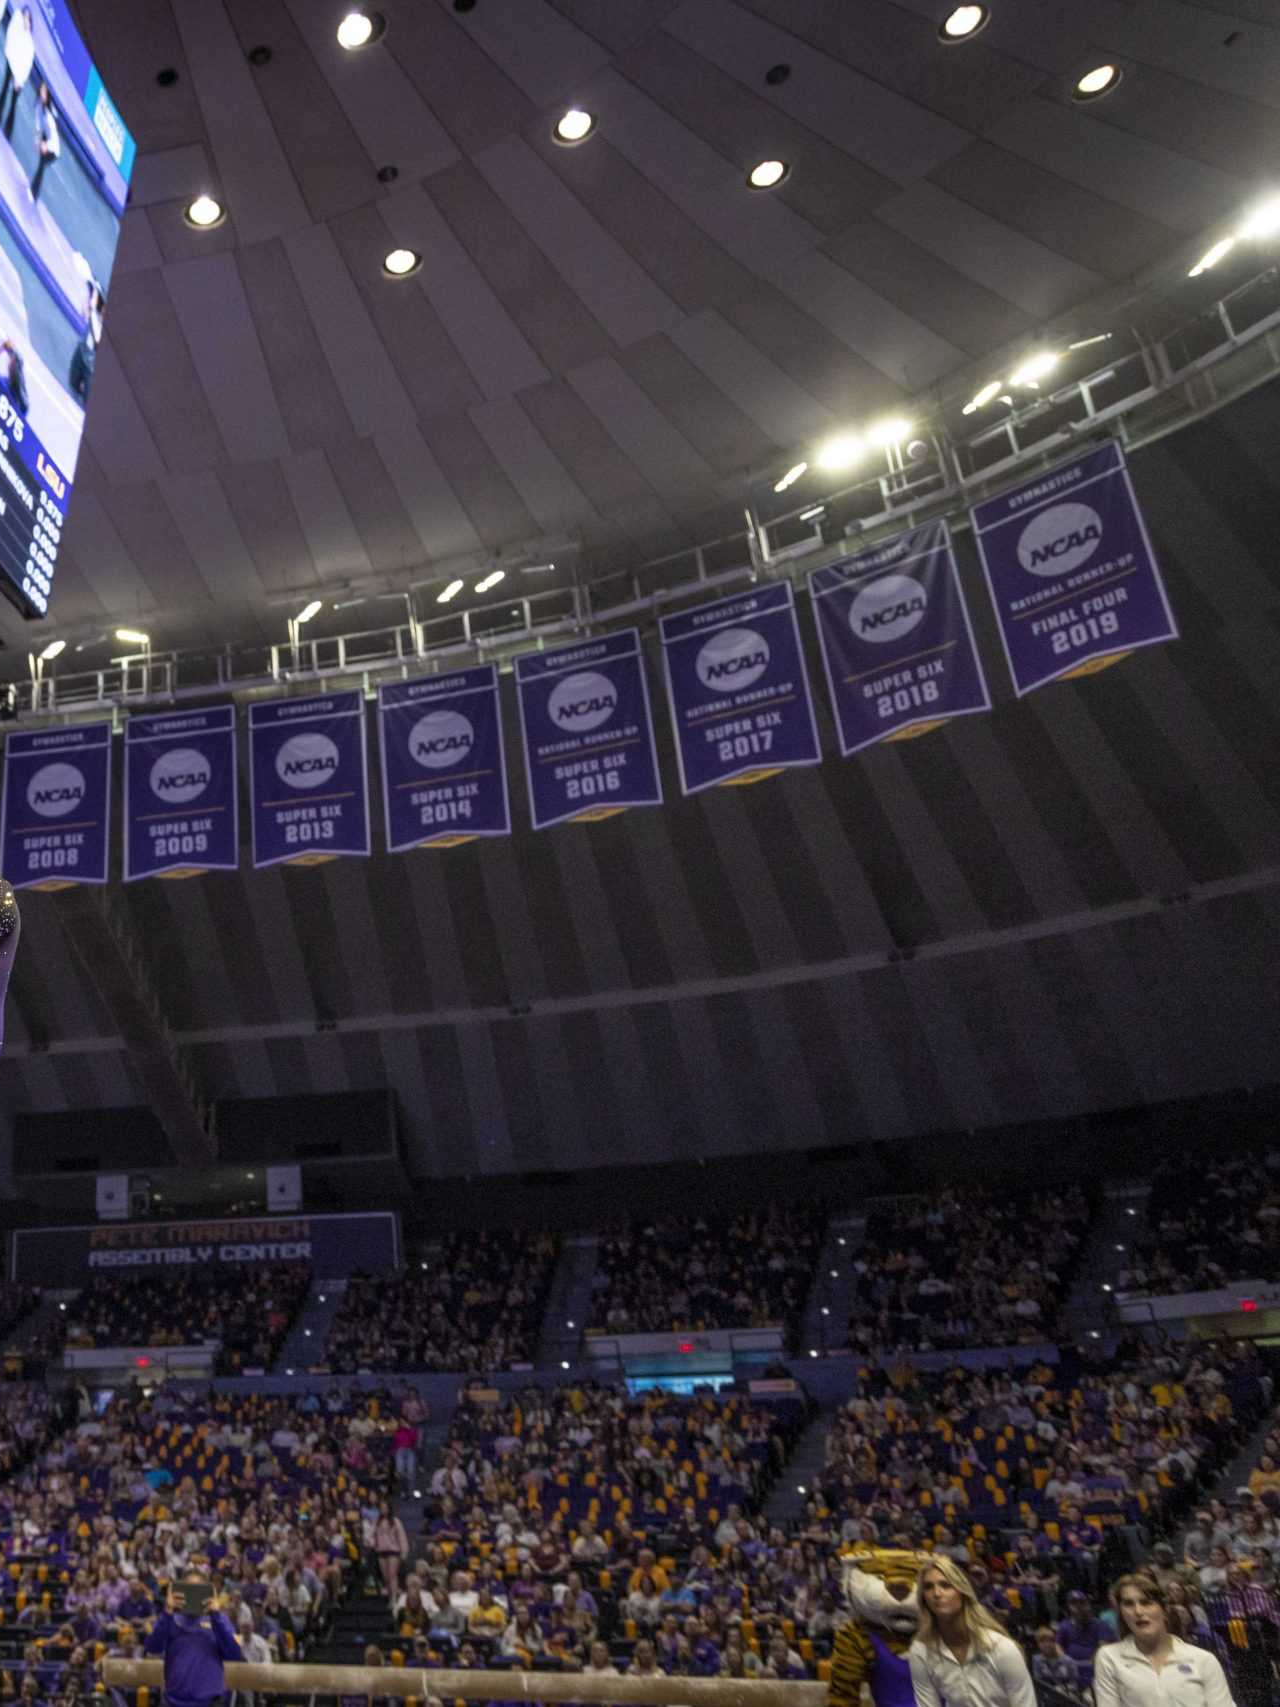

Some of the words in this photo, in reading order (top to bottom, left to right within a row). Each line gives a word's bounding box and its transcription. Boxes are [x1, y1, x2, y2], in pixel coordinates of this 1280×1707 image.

[1029, 525, 1100, 567] NCAA
[1011, 578, 1064, 611] NATIONAL
[1067, 553, 1134, 587] RUNNER-UP
[860, 600, 922, 633] NCAA
[1032, 608, 1078, 635] FINAL
[1083, 587, 1128, 615] FOUR
[1051, 611, 1119, 654] 2019
[706, 652, 766, 681] NCAA
[863, 670, 913, 698] SUPER
[917, 659, 944, 679] SIX
[558, 695, 613, 722] NCAA
[877, 680, 939, 718] 2018
[705, 718, 753, 742] SUPER
[756, 711, 782, 728] SIX
[417, 734, 470, 755] NCAA
[719, 730, 773, 761] 2017
[284, 757, 336, 775] NCAA
[555, 761, 600, 780] SUPER
[603, 753, 627, 769] SIX
[158, 772, 208, 790] NCAA
[411, 787, 453, 805] SUPER
[456, 783, 479, 797] SIX
[566, 771, 620, 799] 2016
[34, 787, 84, 804] NCAA
[276, 807, 317, 824] SUPER
[320, 804, 342, 818] SIX
[421, 799, 472, 825] 2014
[24, 835, 61, 849] SUPER
[64, 833, 85, 845] SIX
[149, 821, 188, 837] SUPER
[192, 819, 213, 832] SIX
[285, 820, 334, 843] 2013
[28, 848, 79, 869] 2008
[155, 834, 208, 857] 2009
[89, 1246, 213, 1267] ASSEMBLY
[220, 1242, 312, 1261] CENTER
